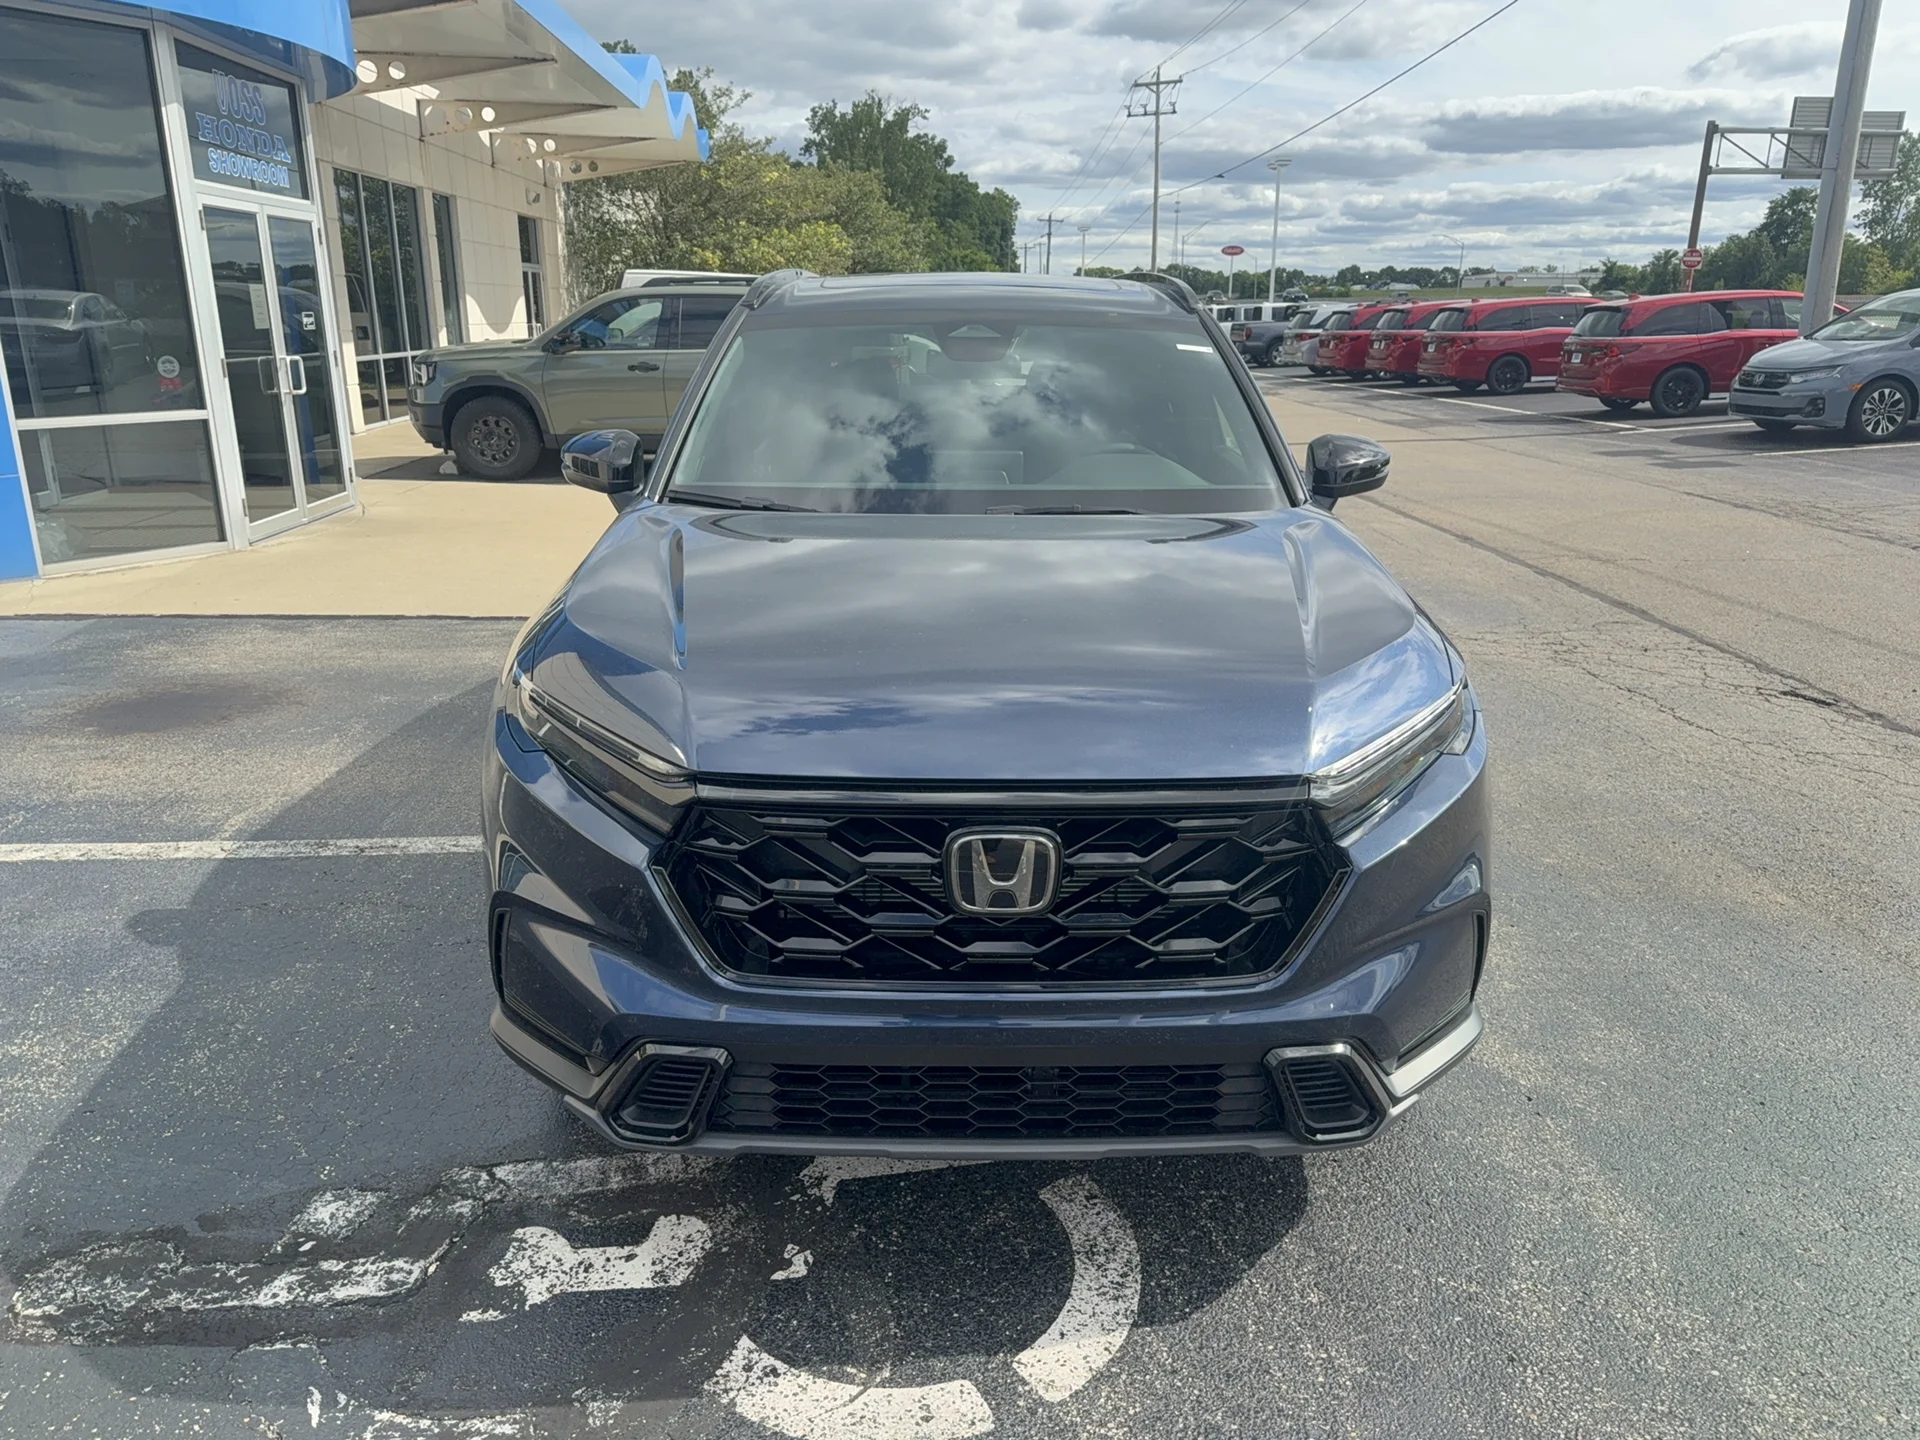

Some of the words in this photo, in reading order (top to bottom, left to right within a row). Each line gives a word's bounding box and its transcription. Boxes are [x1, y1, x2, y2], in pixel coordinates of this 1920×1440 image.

[212, 69, 266, 125] VOSS
[196, 112, 291, 163] HONDA
[208, 148, 289, 188] SHOWROOM
